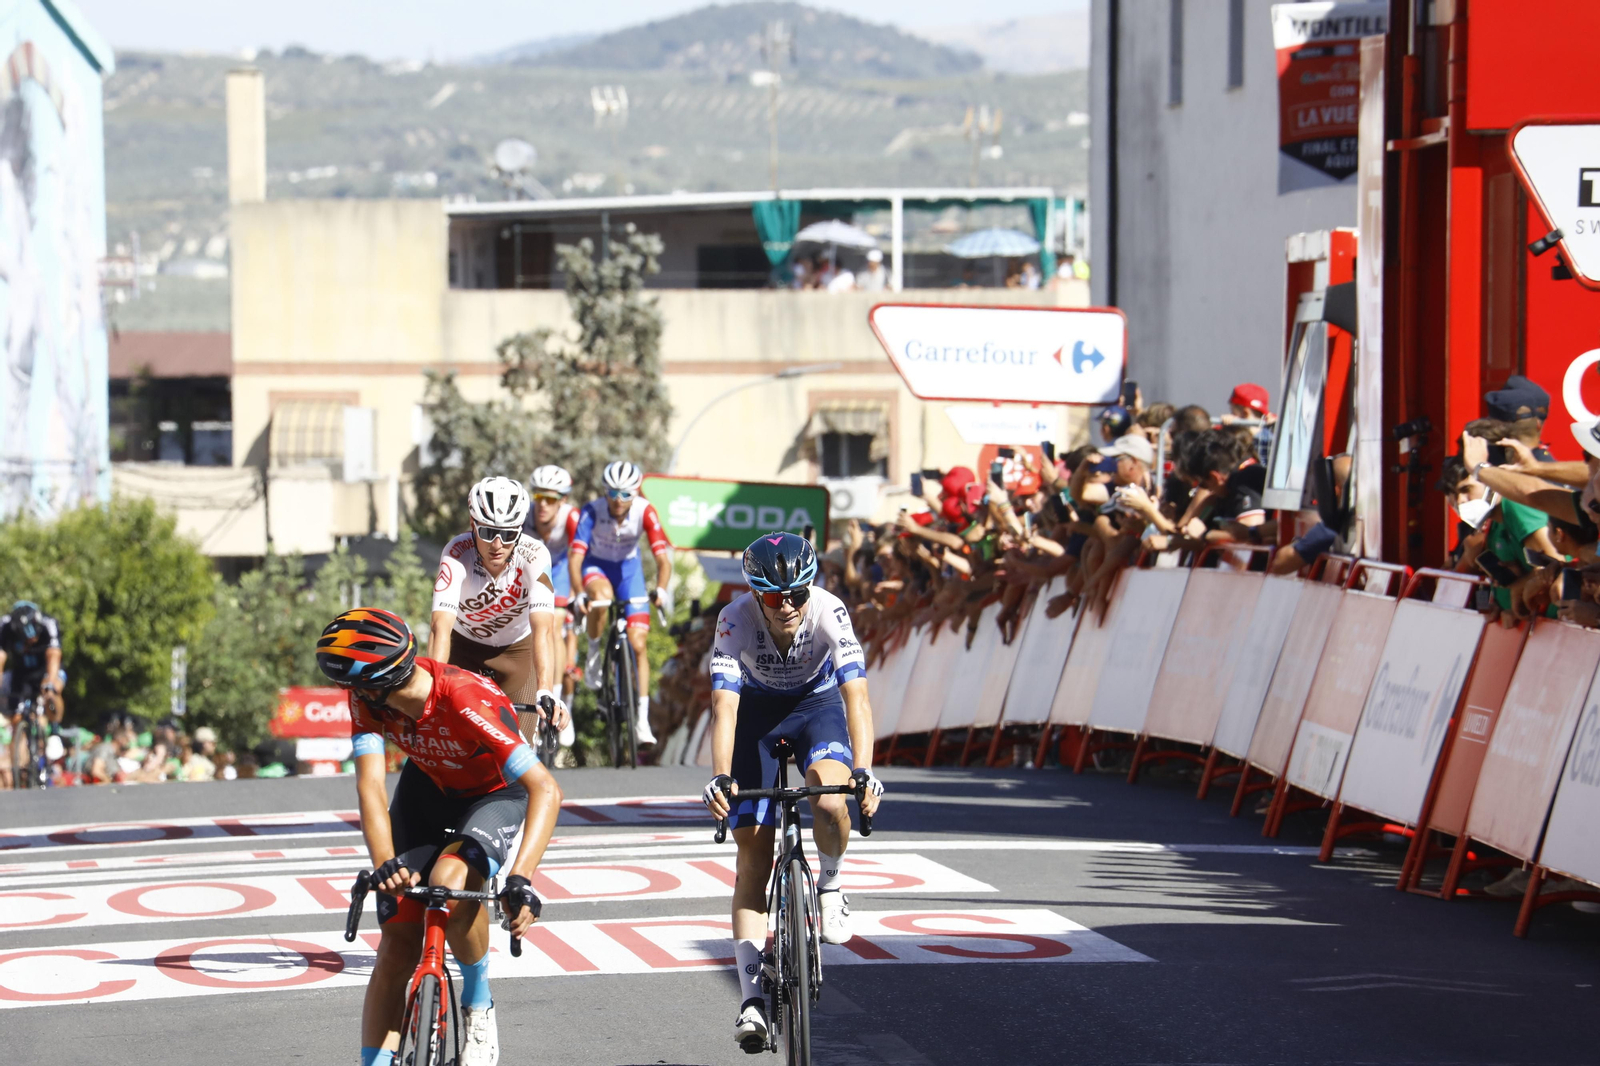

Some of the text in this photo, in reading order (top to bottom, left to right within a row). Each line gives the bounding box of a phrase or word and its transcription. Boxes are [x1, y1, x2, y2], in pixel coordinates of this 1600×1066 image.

[904, 339, 1038, 365] Carrefour
[459, 582, 503, 612] AG2R
[460, 707, 516, 745] MERIDA
[386, 732, 462, 751] AHRAIN
